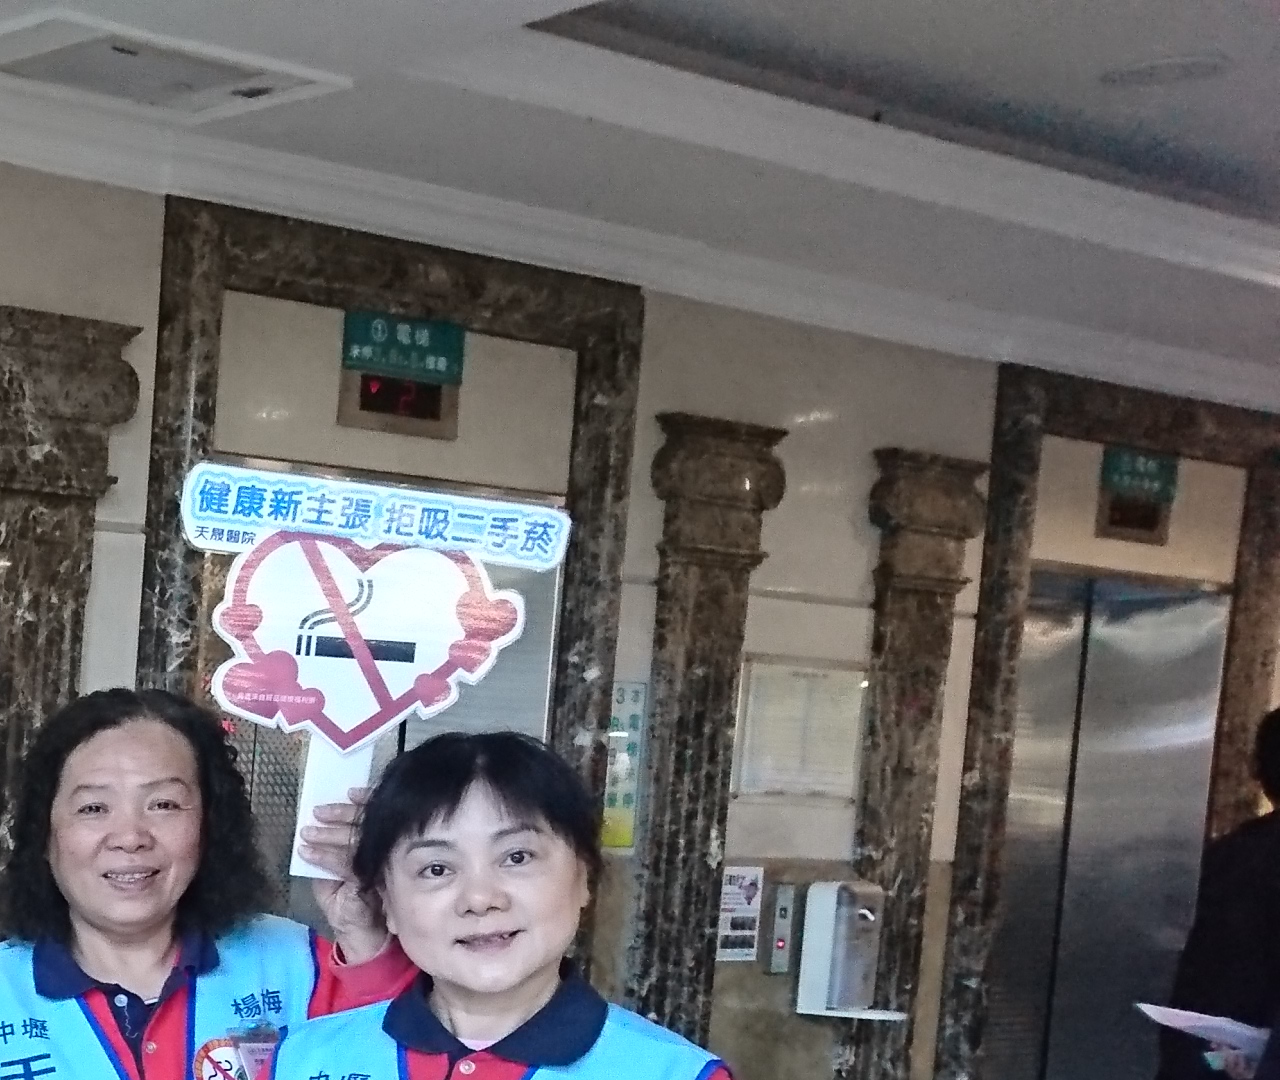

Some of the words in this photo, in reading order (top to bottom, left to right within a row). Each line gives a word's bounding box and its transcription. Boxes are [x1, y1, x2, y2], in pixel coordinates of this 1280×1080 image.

[195, 525, 255, 545] 天晟醫院
[198, 479, 371, 531] 健康新主張
[383, 502, 557, 554] 拒吸二手菸
